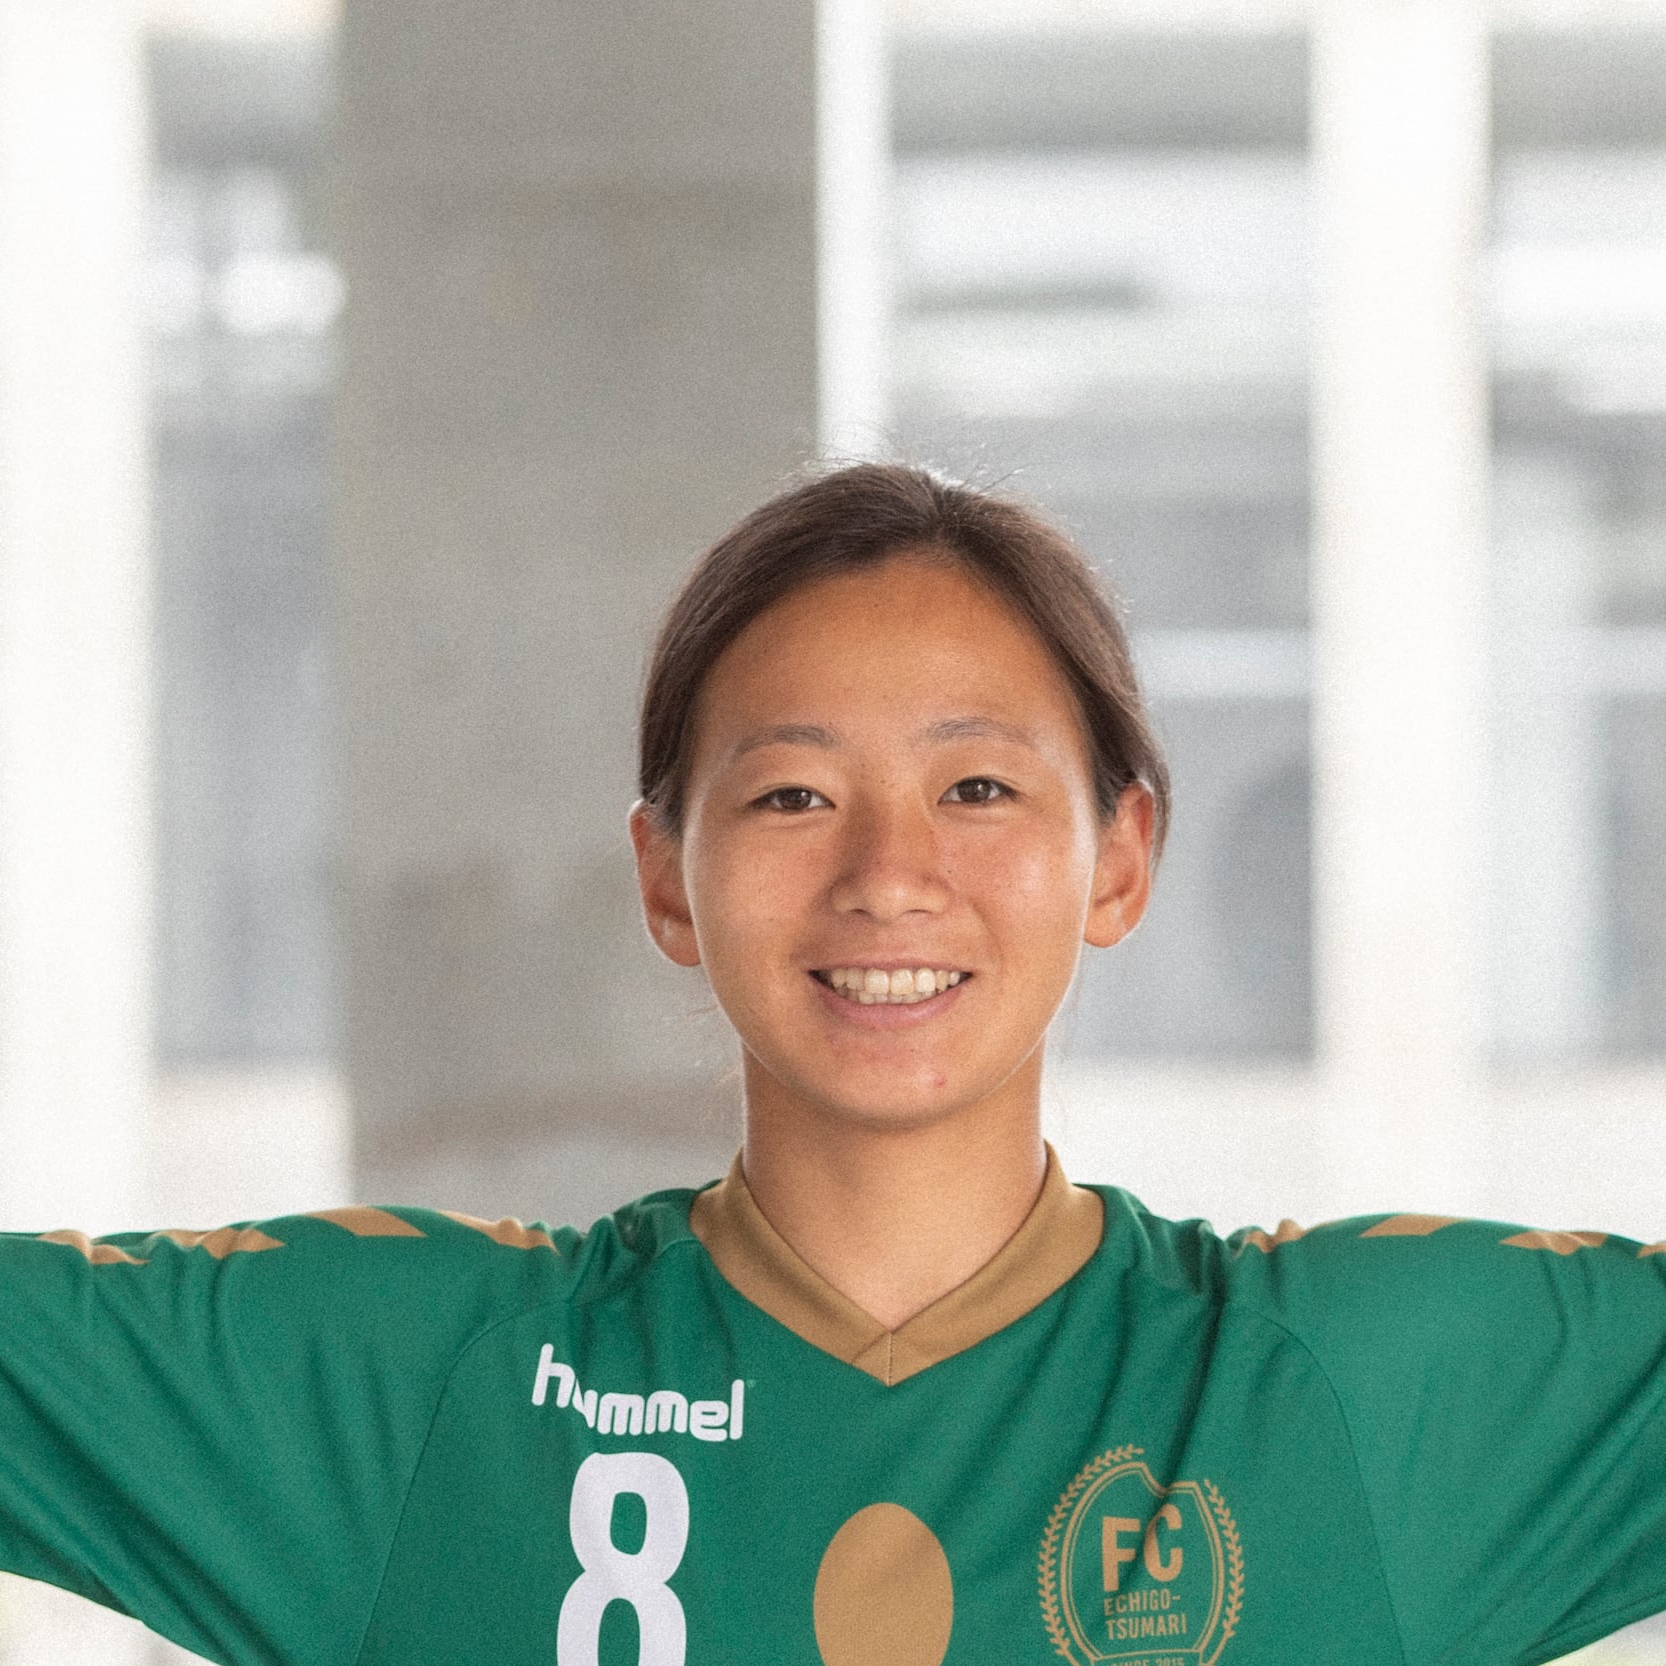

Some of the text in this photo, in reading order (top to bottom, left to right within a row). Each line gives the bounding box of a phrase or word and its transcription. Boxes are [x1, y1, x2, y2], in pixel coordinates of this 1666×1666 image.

[532, 1343, 745, 1442] hummel
[1102, 1503, 1183, 1592] FC
[1104, 1588, 1181, 1616] ECHIGO-
[1105, 1612, 1187, 1640] TSUMARI
